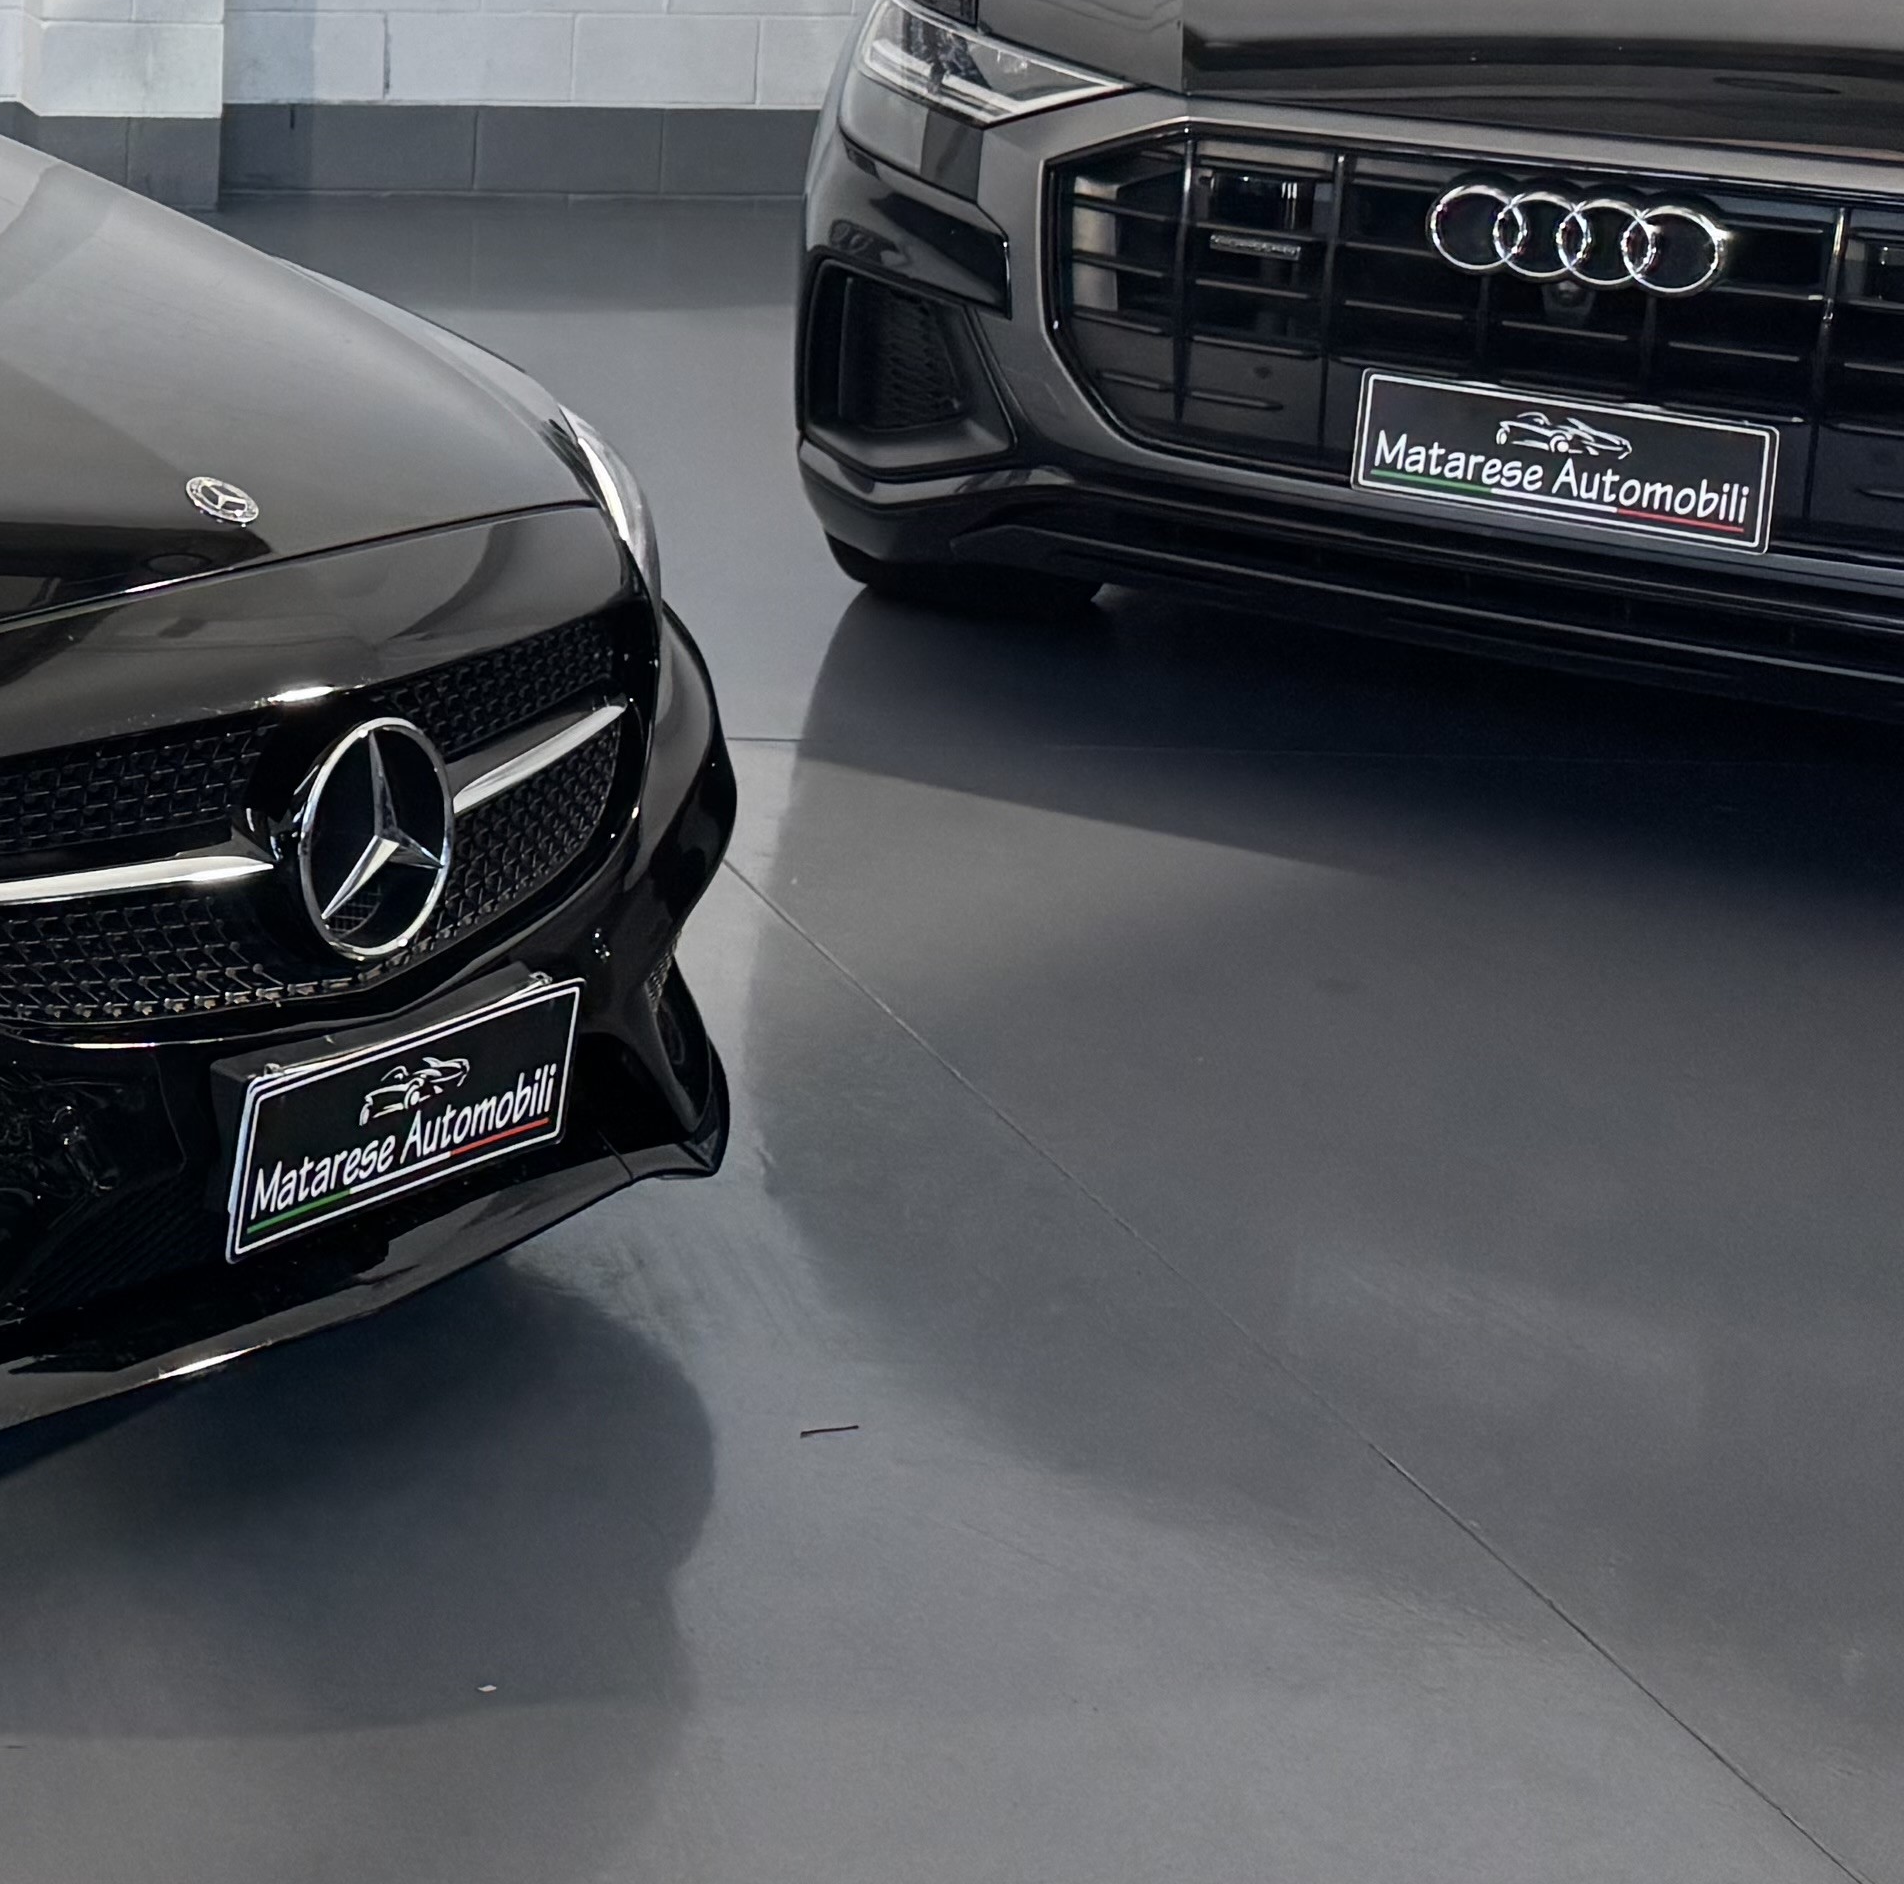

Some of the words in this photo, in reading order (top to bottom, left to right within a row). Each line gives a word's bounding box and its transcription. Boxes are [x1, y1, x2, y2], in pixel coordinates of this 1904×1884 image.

[1374, 429, 1544, 493] Matarese
[1551, 456, 1751, 524] Automobili
[250, 1134, 397, 1220] Matarese
[399, 1062, 558, 1164] Automobili
